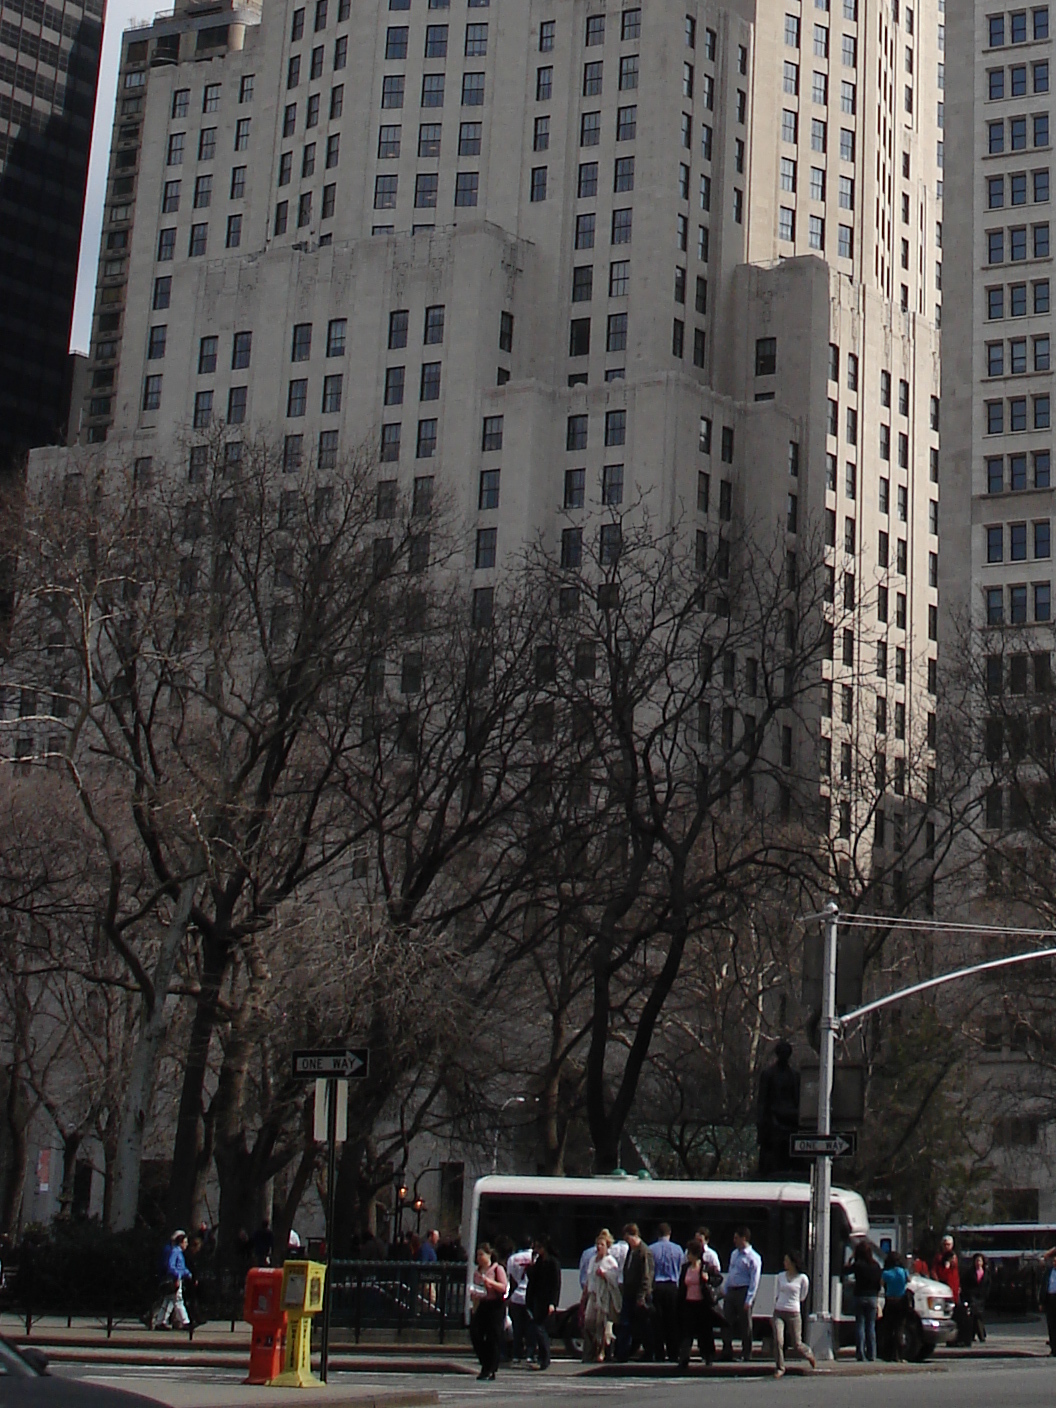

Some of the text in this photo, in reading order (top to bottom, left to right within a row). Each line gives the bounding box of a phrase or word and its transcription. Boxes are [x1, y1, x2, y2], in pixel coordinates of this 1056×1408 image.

[302, 1057, 356, 1070] ONE WAY
[799, 1141, 844, 1150] ONE WAY
